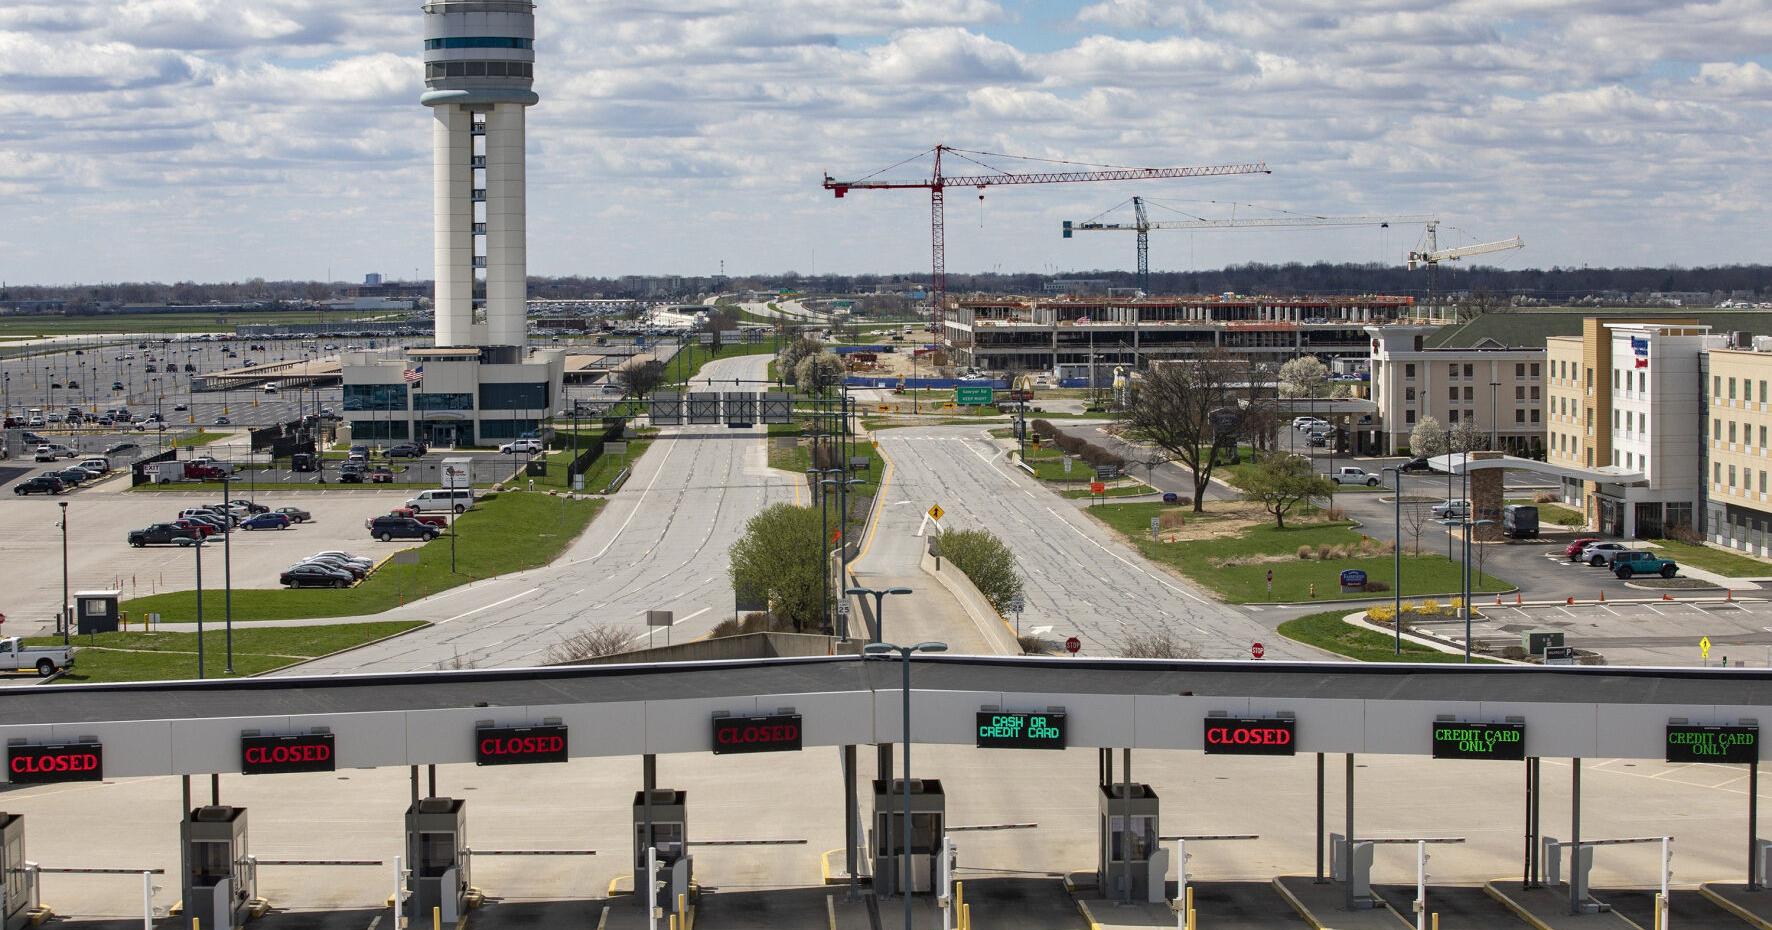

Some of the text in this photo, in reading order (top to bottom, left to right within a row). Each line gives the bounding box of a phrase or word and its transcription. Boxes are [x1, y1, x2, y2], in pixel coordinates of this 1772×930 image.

[838, 606, 850, 614] 25
[1066, 641, 1080, 649] STOP
[992, 715, 1047, 728] CASH OR
[718, 724, 799, 744] CLOSED
[979, 726, 1060, 739] CREDIT CARD
[1206, 727, 1291, 745] CLOSED
[1435, 729, 1521, 742] CREDIT CARD
[1668, 732, 1755, 745] CREDIT CARD
[480, 734, 565, 756] CLOSED
[1458, 740, 1497, 752] ONLY
[1692, 743, 1730, 755] ONLY
[244, 744, 331, 765] CLOSED
[11, 753, 98, 773] CLOSED
